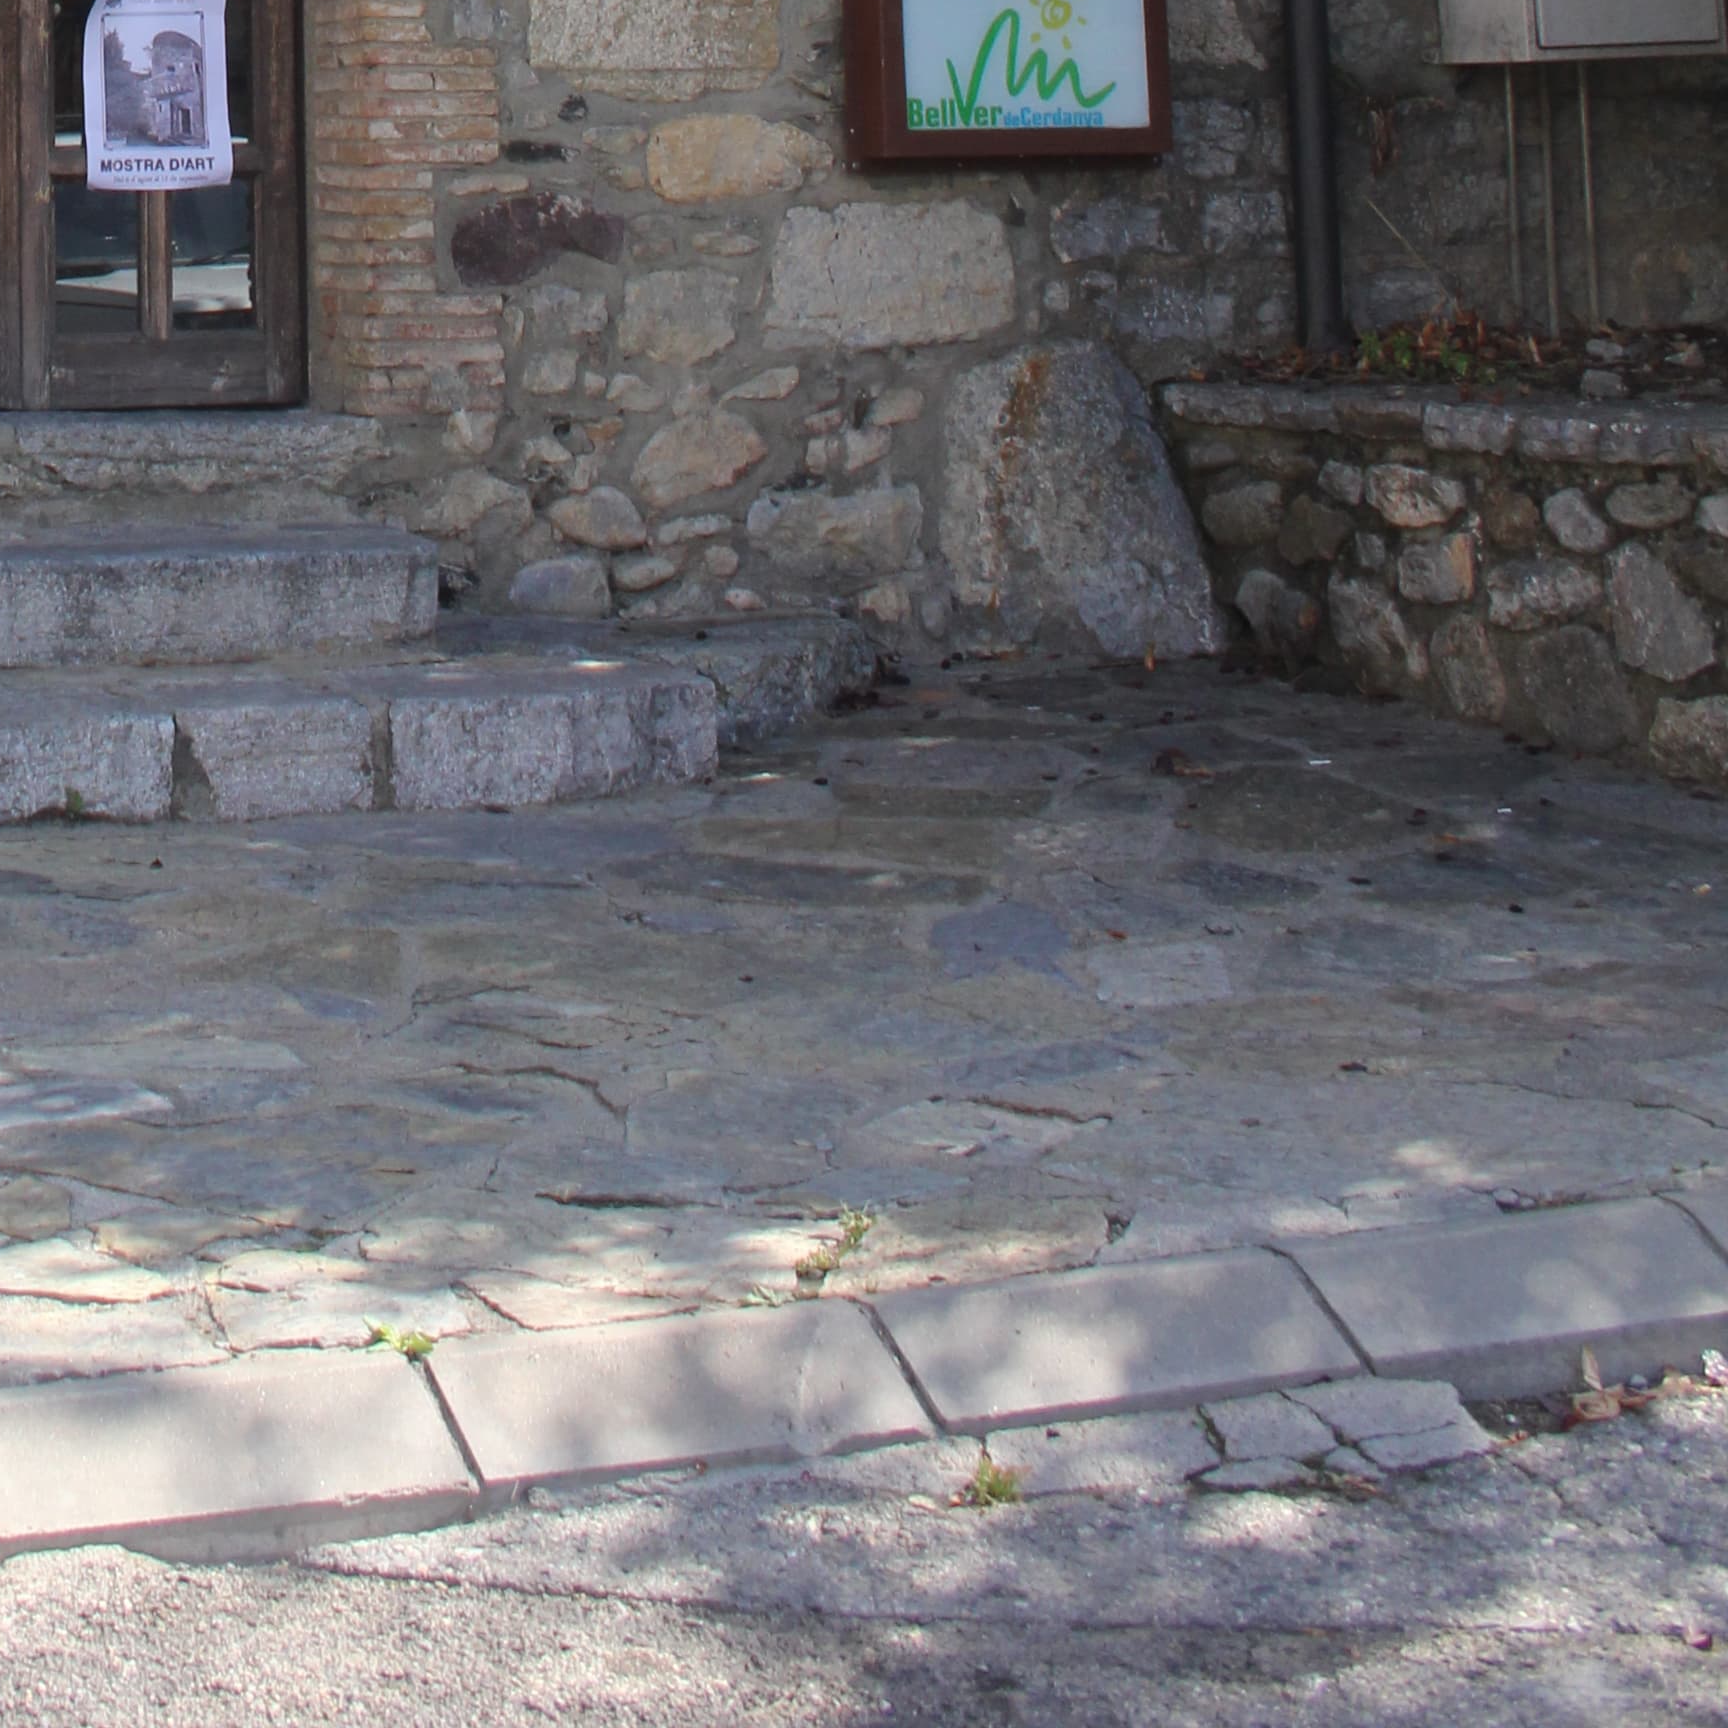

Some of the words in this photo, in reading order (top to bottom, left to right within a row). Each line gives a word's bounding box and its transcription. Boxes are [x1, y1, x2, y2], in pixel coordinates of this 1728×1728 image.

[1020, 106, 1104, 127] Cerdanya
[99, 157, 165, 173] MOSTRA
[168, 155, 216, 172] D'ART
